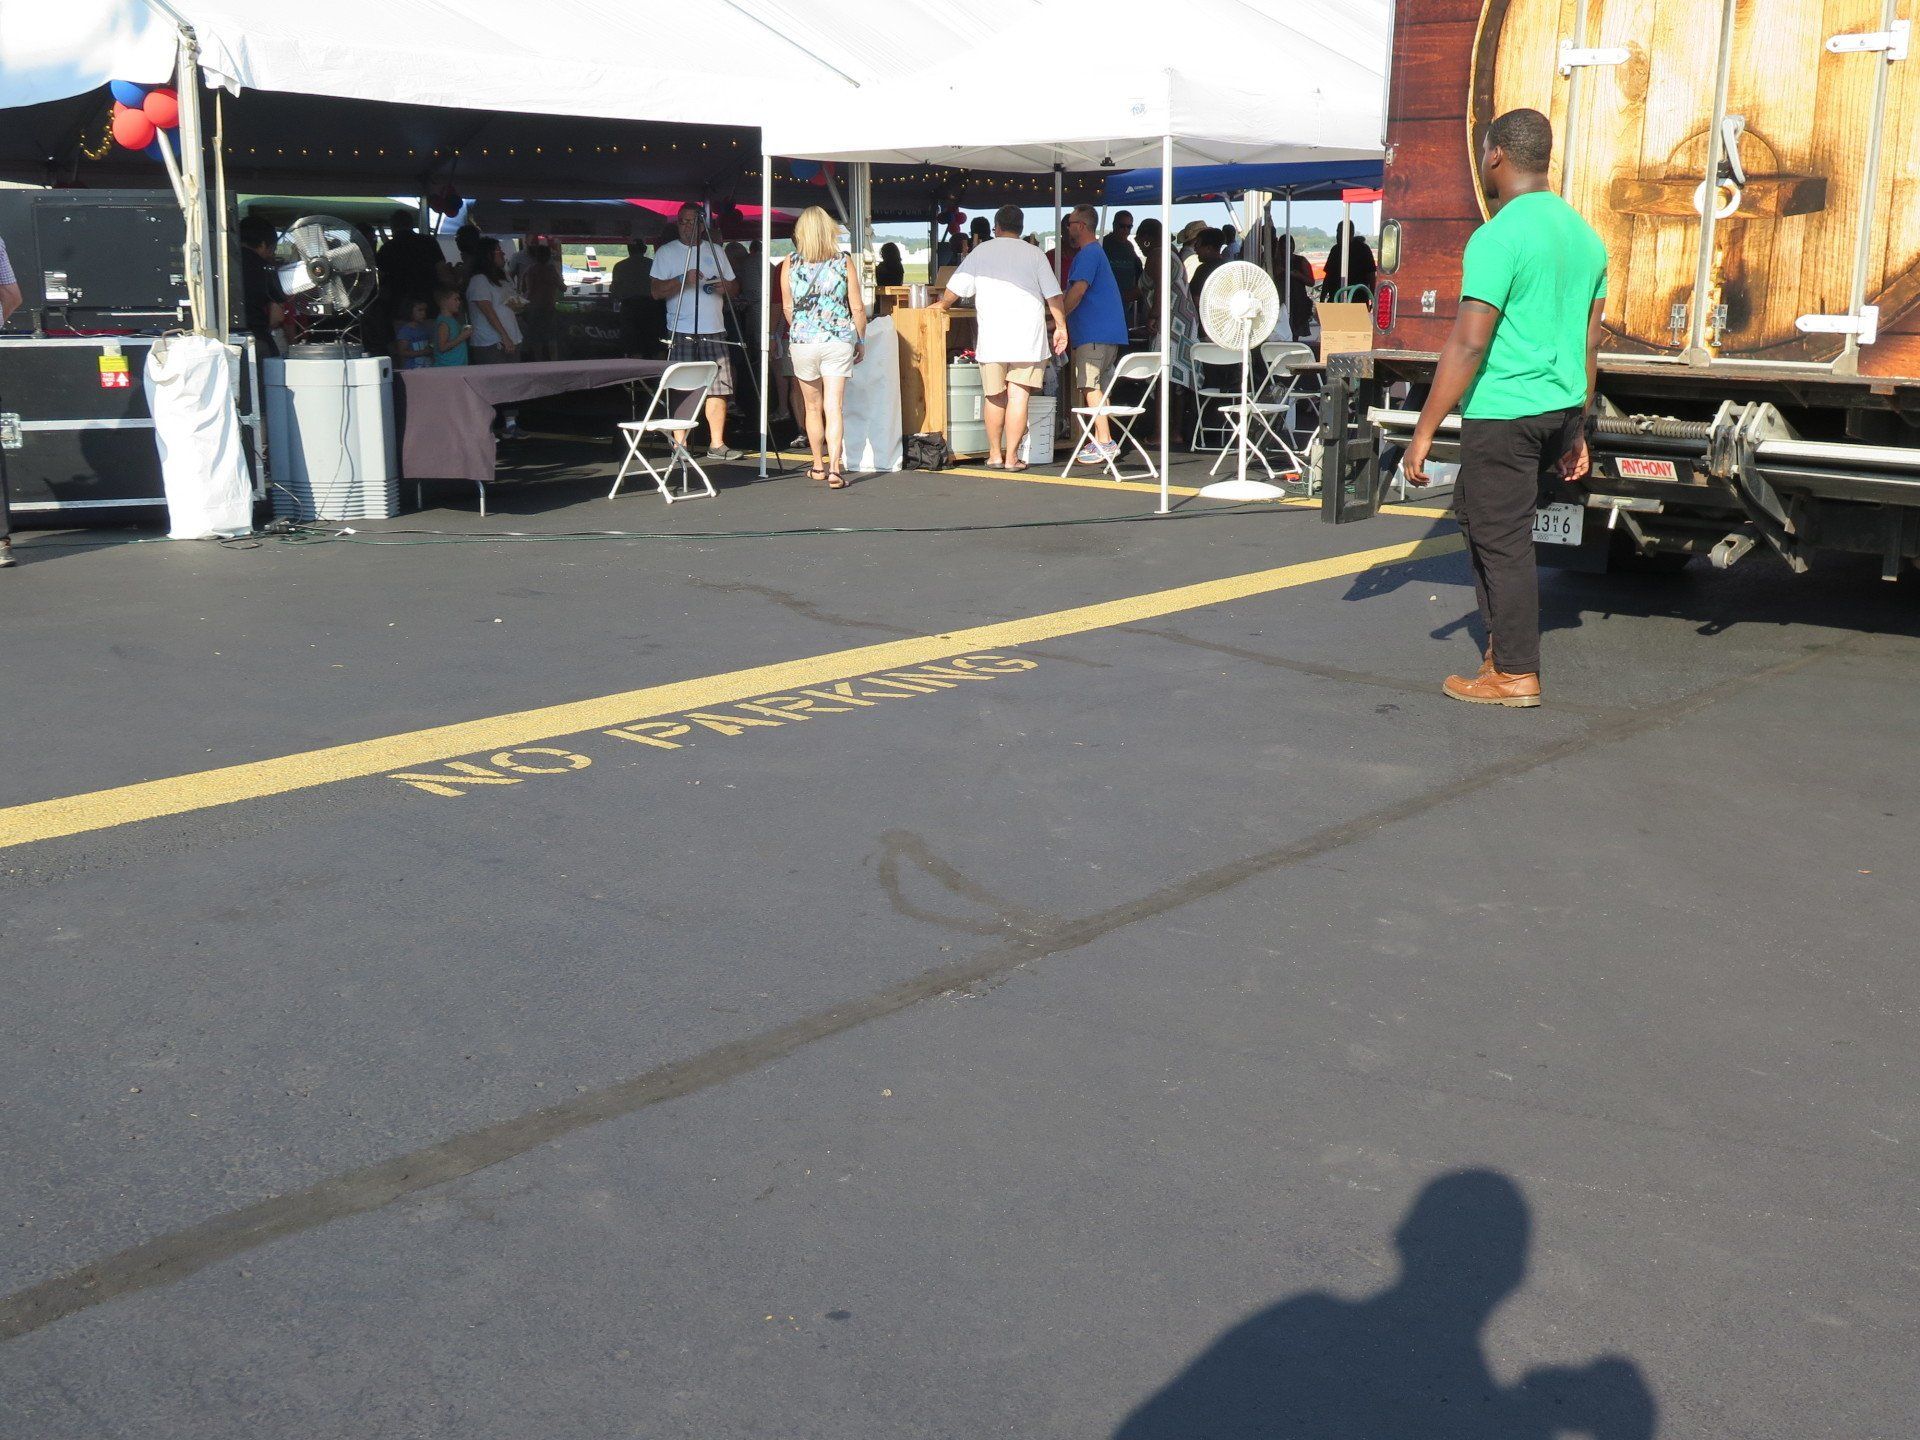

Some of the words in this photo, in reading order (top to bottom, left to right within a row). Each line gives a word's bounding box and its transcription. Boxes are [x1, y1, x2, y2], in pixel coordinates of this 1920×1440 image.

[1621, 459, 1673, 477] ANTHONY
[386, 747, 592, 797] NO
[602, 655, 1039, 749] PARKING
